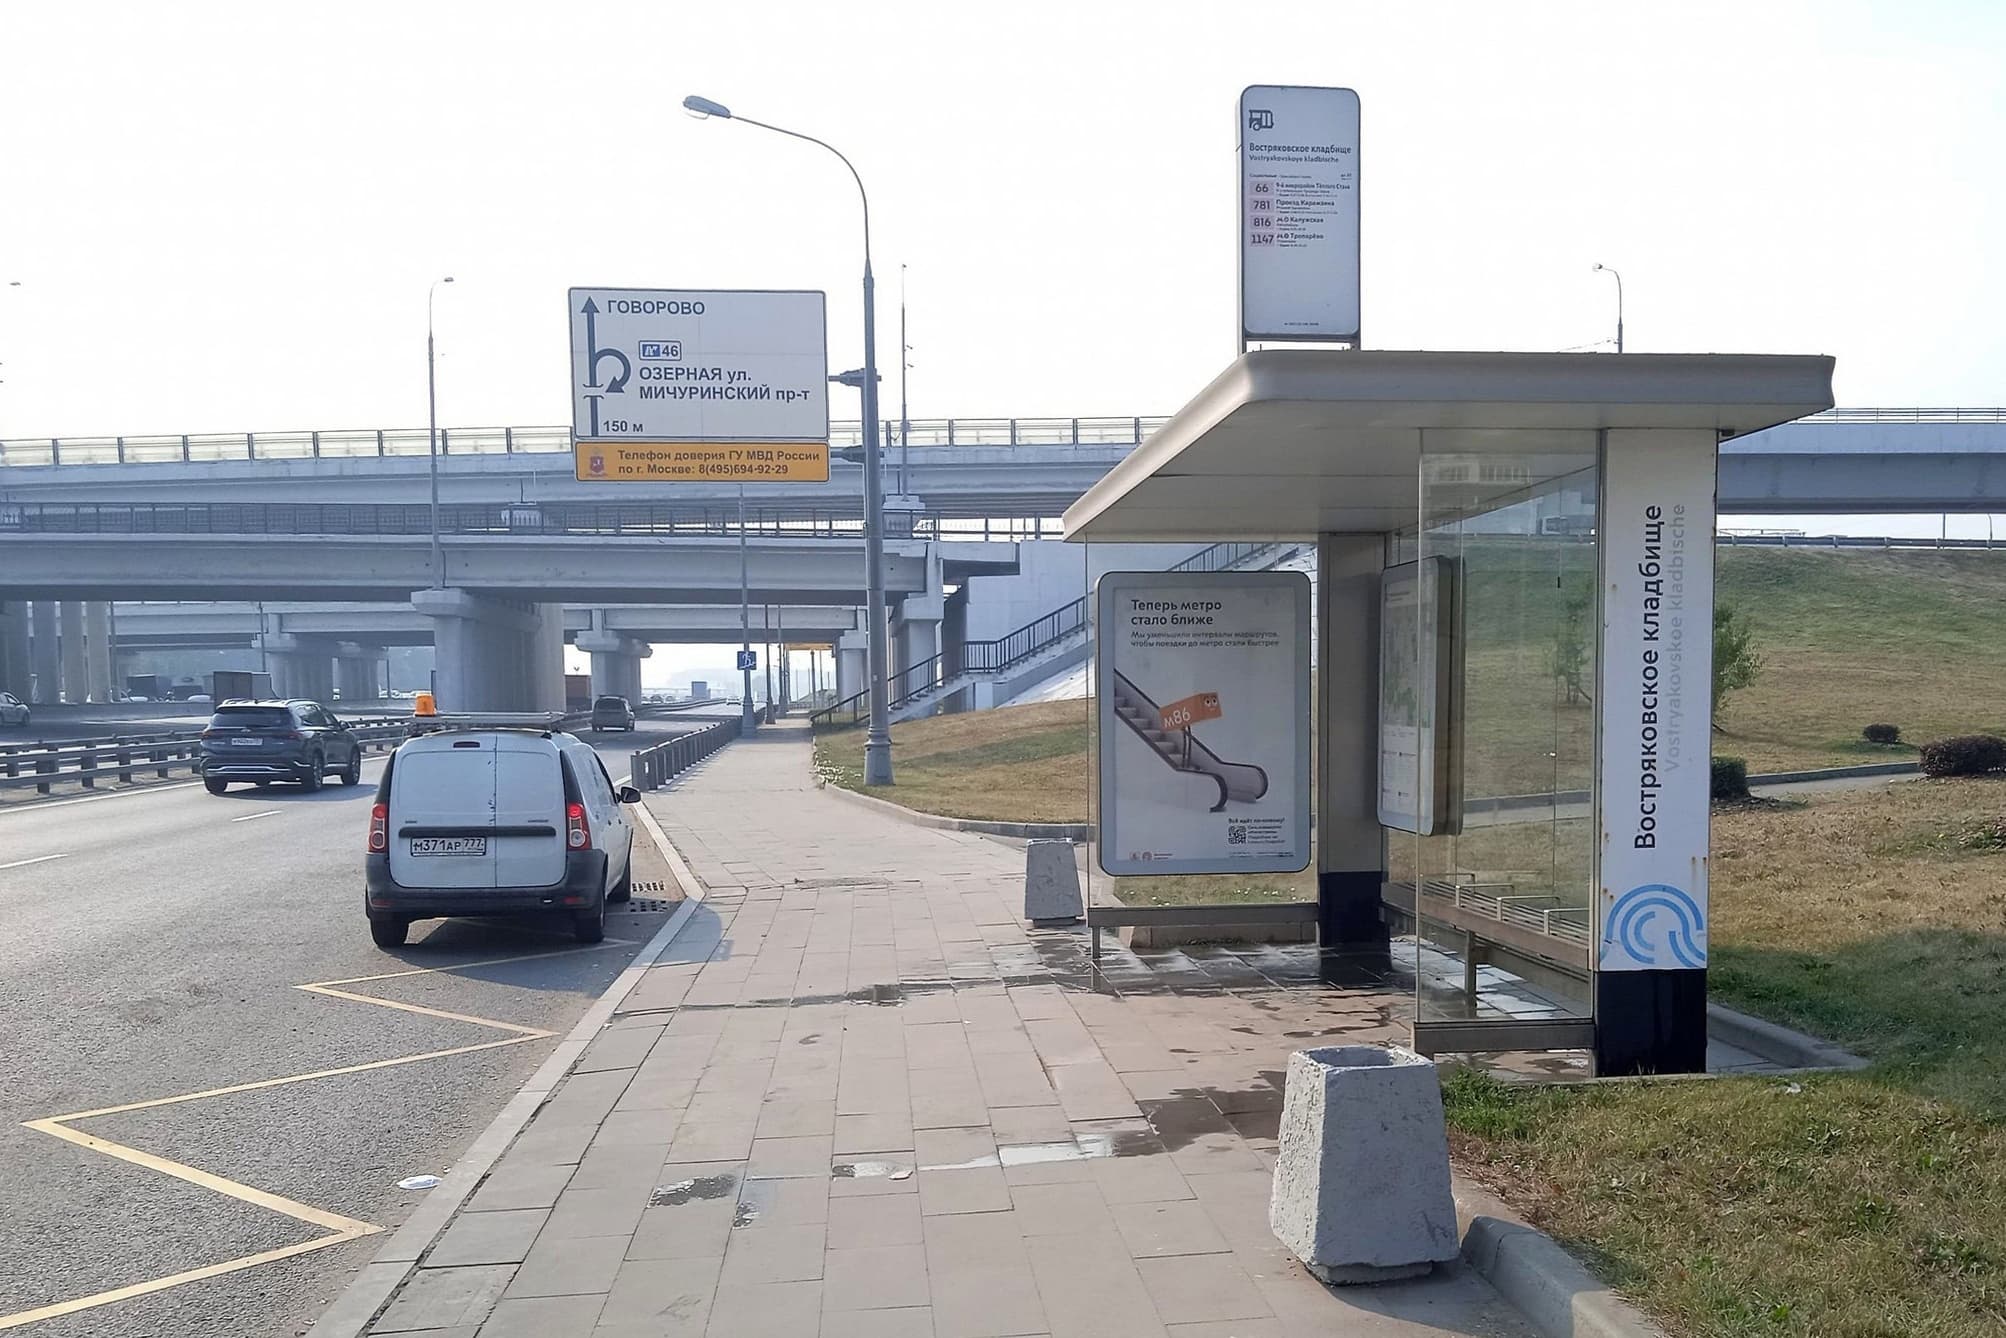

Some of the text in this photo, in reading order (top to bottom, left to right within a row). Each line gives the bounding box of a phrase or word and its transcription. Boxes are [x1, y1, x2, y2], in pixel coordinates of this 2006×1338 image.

[1249, 142, 1352, 154] Востряковское кладбище
[1255, 184, 1269, 192] 66
[1253, 201, 1270, 210] 781
[1253, 218, 1271, 227] 816
[1251, 234, 1274, 244] 1147
[607, 300, 705, 315] ГОВОРОВО
[662, 345, 679, 357] 46
[639, 367, 751, 384] ОЗЕРНАЯ ул.
[639, 384, 810, 403] МИЧУРИНСКИЙ пр-т
[603, 421, 643, 433] 150 м
[618, 450, 820, 463] Телефон доверия ГУ МВД России
[618, 464, 789, 476] по г. Москве: 8(495)694-92-29
[1131, 599, 1222, 613] Теперь метро
[1131, 613, 1214, 625] стало ближе
[1663, 504, 1686, 774] Vostryakovskoe kladbische
[1634, 504, 1665, 849] Востряковское кладбище
